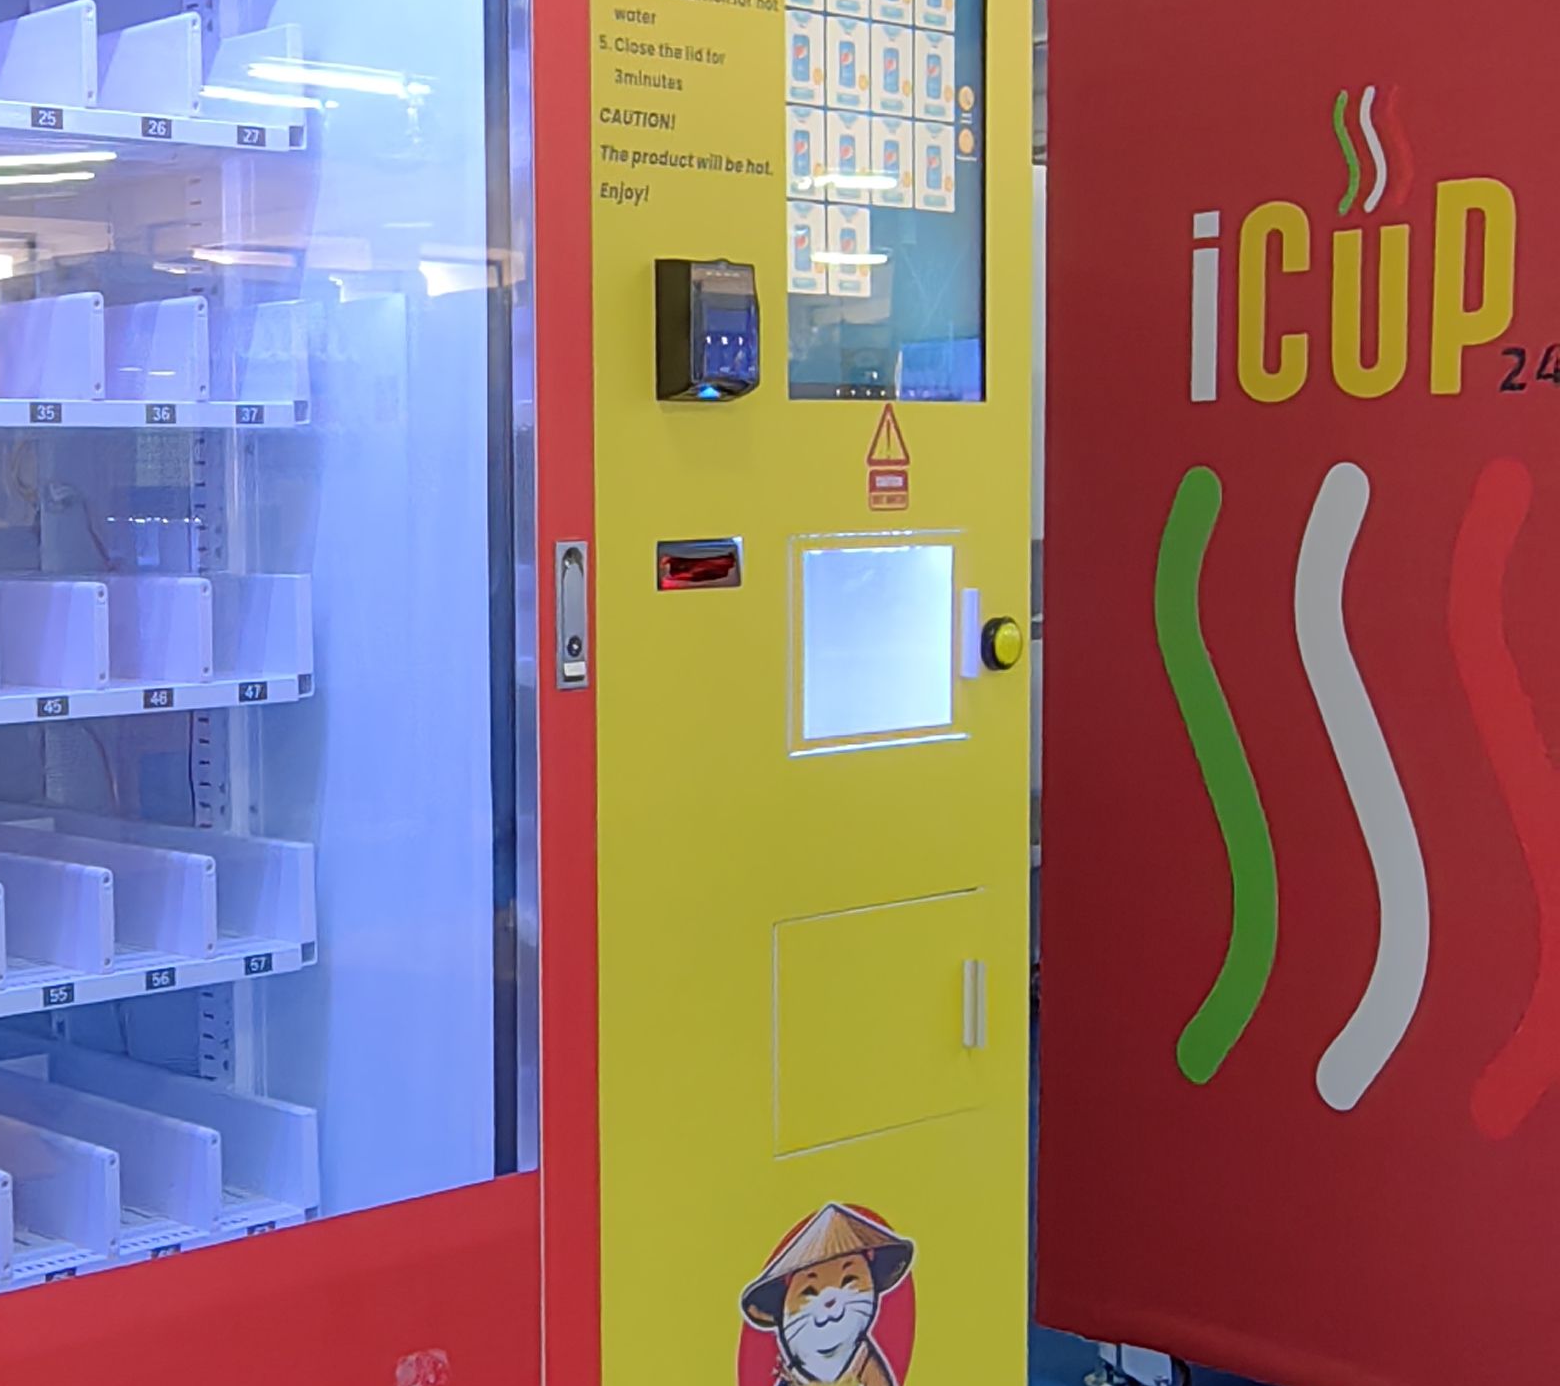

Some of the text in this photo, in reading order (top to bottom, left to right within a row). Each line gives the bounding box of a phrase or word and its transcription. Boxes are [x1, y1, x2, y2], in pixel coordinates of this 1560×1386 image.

[614, 8, 656, 25] water
[599, 35, 726, 65] 5. Close the lid for
[615, 69, 683, 91] 3minutes
[39, 111, 56, 125] 25
[600, 107, 676, 130] CAUTION!
[149, 121, 166, 135] 26
[244, 129, 259, 143] 27
[601, 145, 774, 176] The product will be hot.
[600, 182, 650, 206] Enjoy!
[1190, 177, 1517, 403] iCUP
[38, 406, 55, 420] 35
[153, 407, 170, 421] 36
[241, 408, 258, 421] 37
[245, 685, 260, 698] 47
[44, 700, 61, 713] 45
[152, 971, 169, 985] 56
[51, 988, 68, 1002] 55
